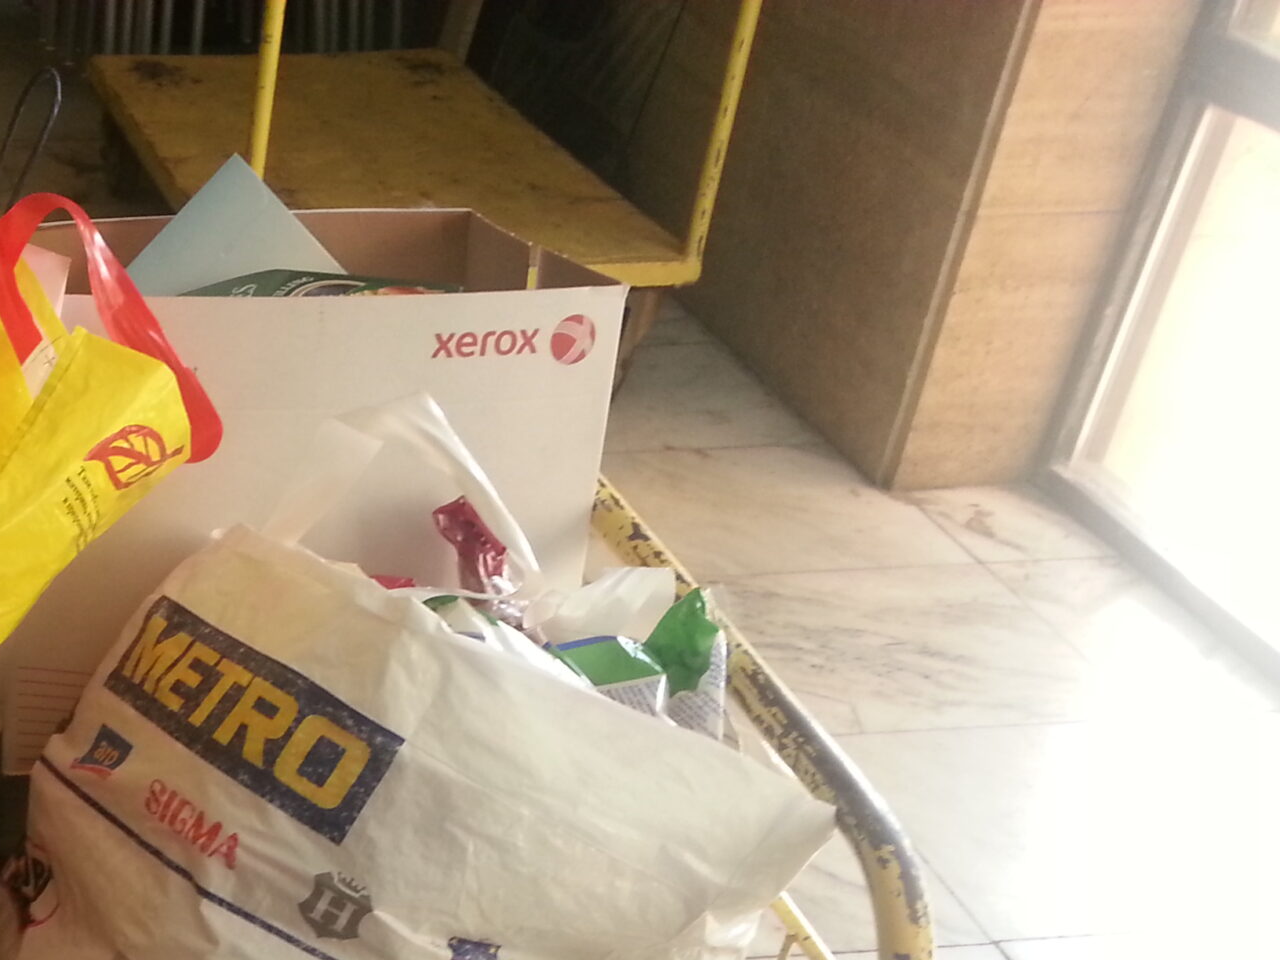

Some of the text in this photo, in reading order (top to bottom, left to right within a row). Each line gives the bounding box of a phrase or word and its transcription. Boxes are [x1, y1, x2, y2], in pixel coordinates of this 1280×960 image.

[431, 328, 540, 359] xerox
[122, 615, 371, 809] METRO
[144, 778, 239, 870] SIGMA
